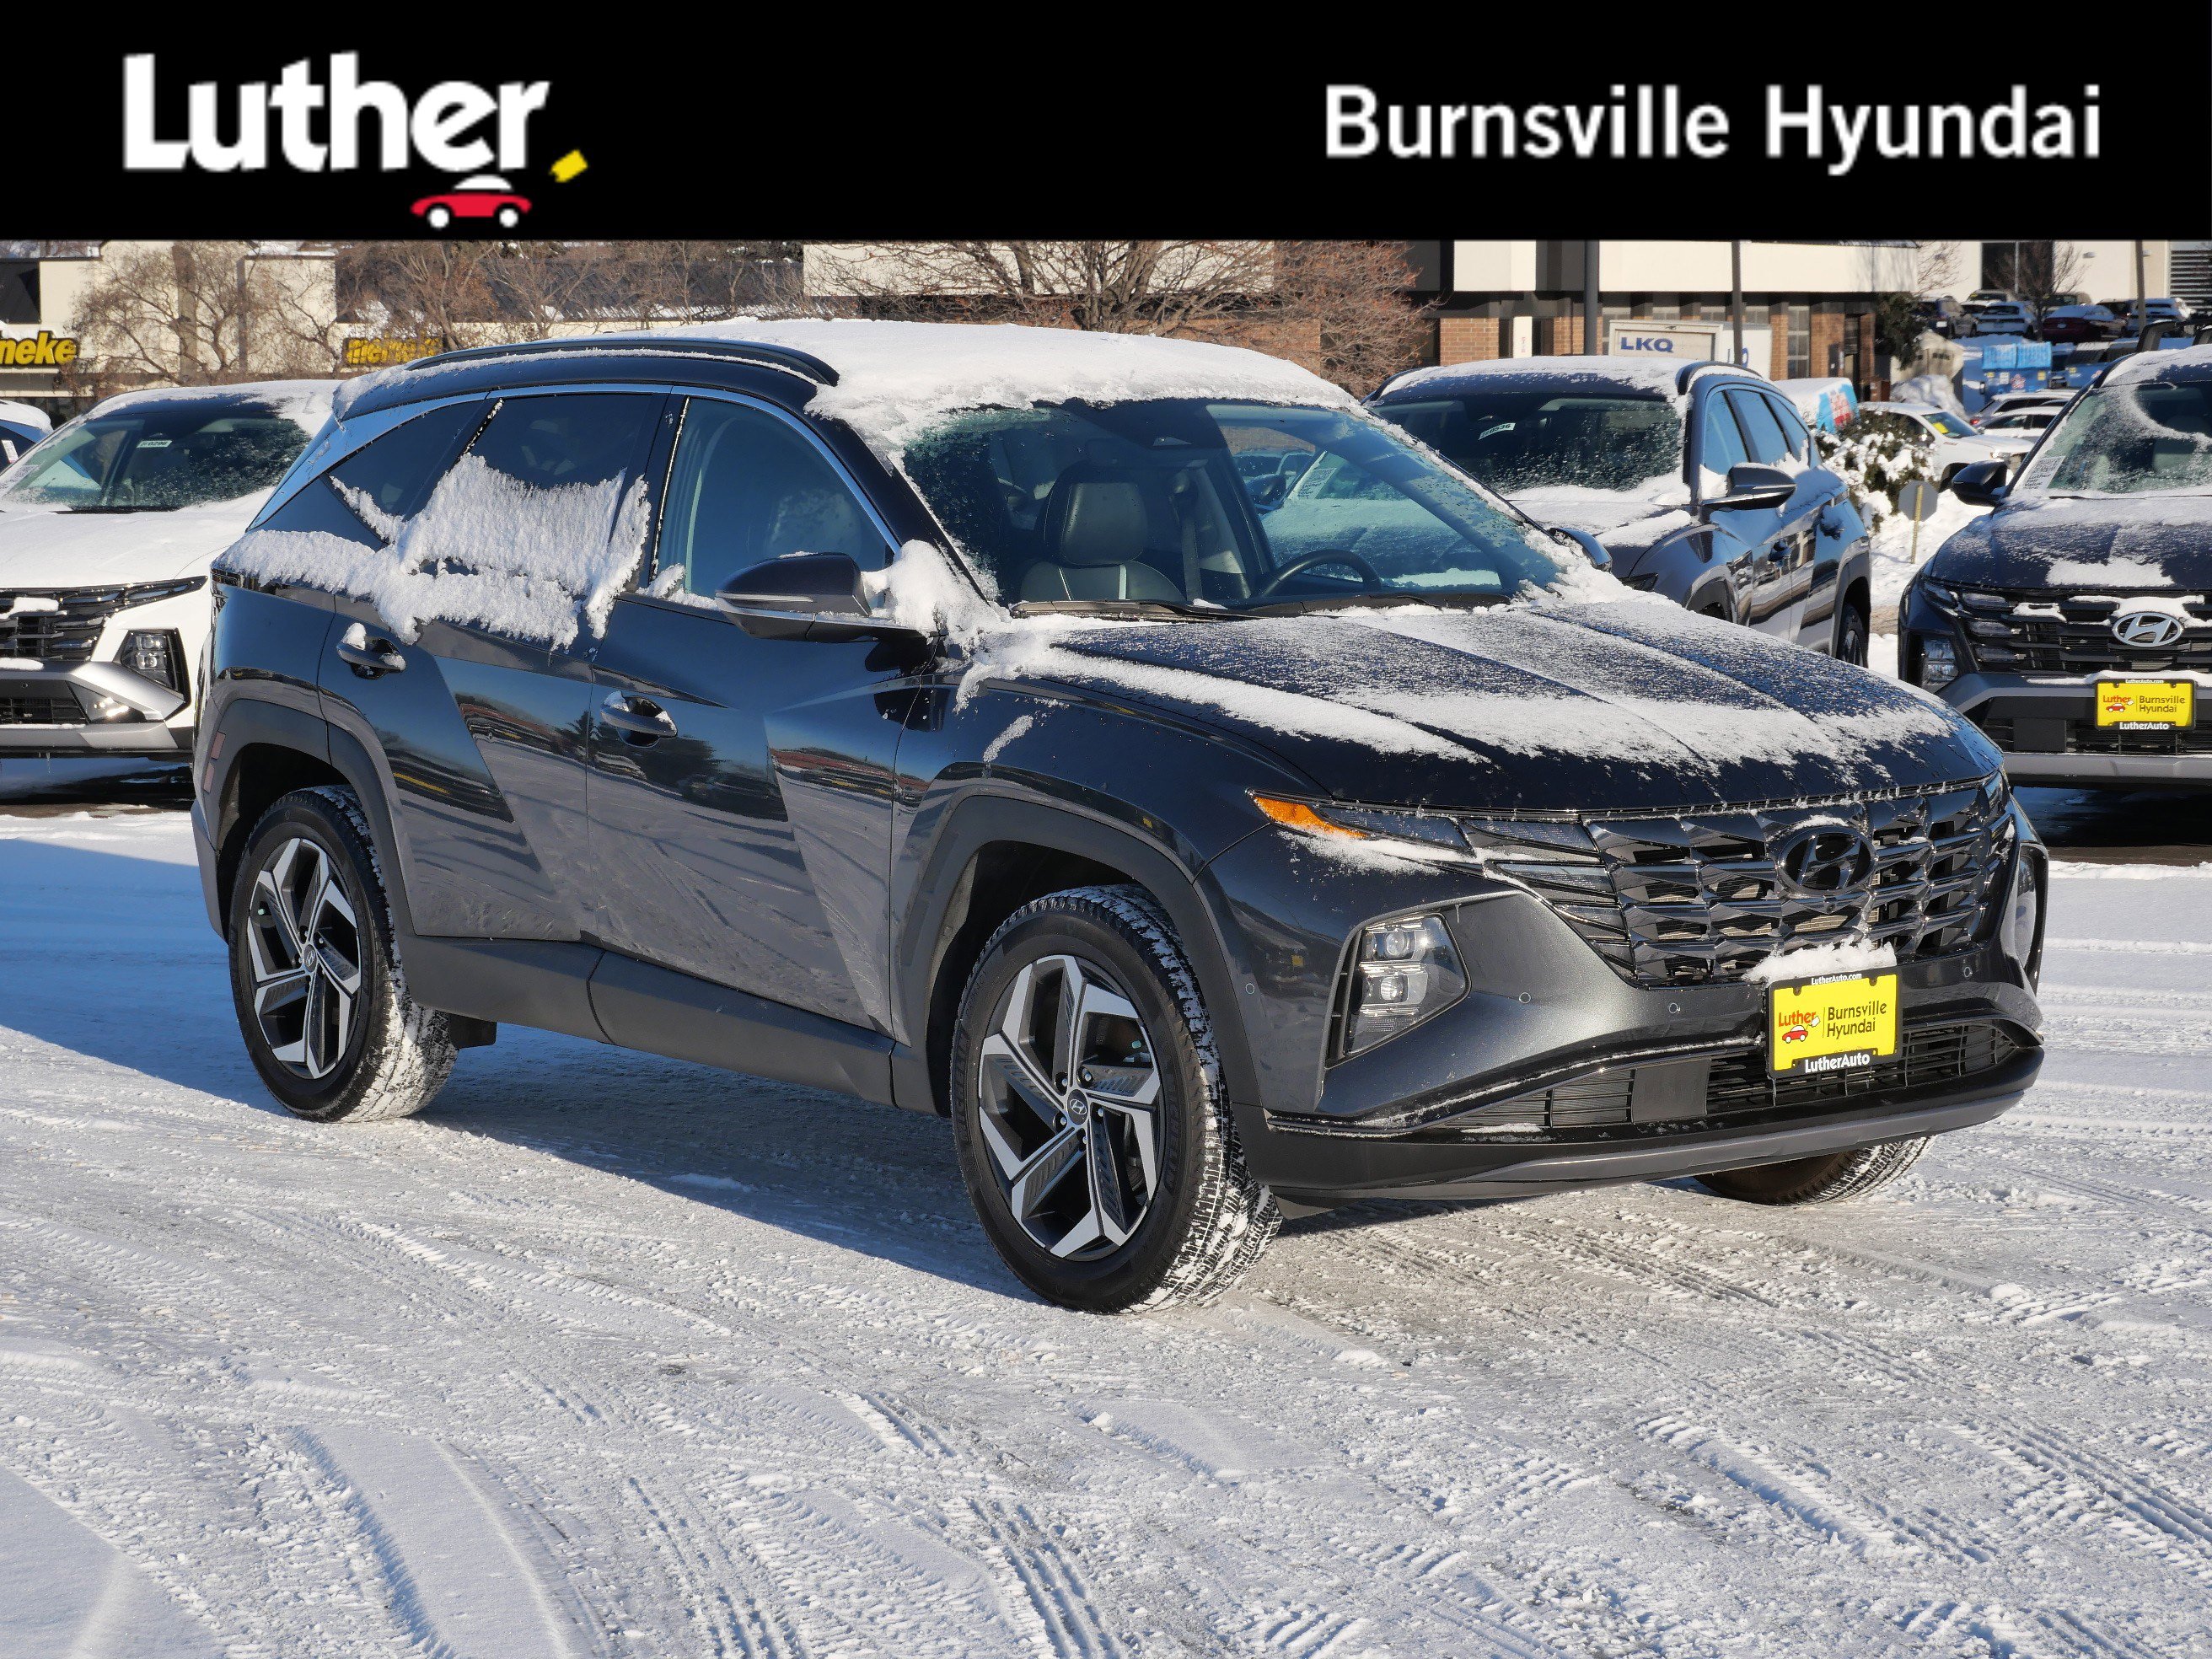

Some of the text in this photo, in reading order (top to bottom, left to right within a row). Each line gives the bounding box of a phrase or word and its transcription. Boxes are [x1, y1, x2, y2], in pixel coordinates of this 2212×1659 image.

[1621, 337, 1673, 352] LKQ
[2140, 695, 2185, 704] Burnsville
[2140, 704, 2177, 714] Hyundai
[2119, 722, 2170, 730] LutherAuto
[1811, 973, 1862, 985] LutherAuto.com
[1778, 1010, 1817, 1027] Luther
[1828, 1001, 1887, 1021] Burnsville
[1827, 1017, 1876, 1039] Hyundai
[1805, 1053, 1870, 1074] LutherAuto
